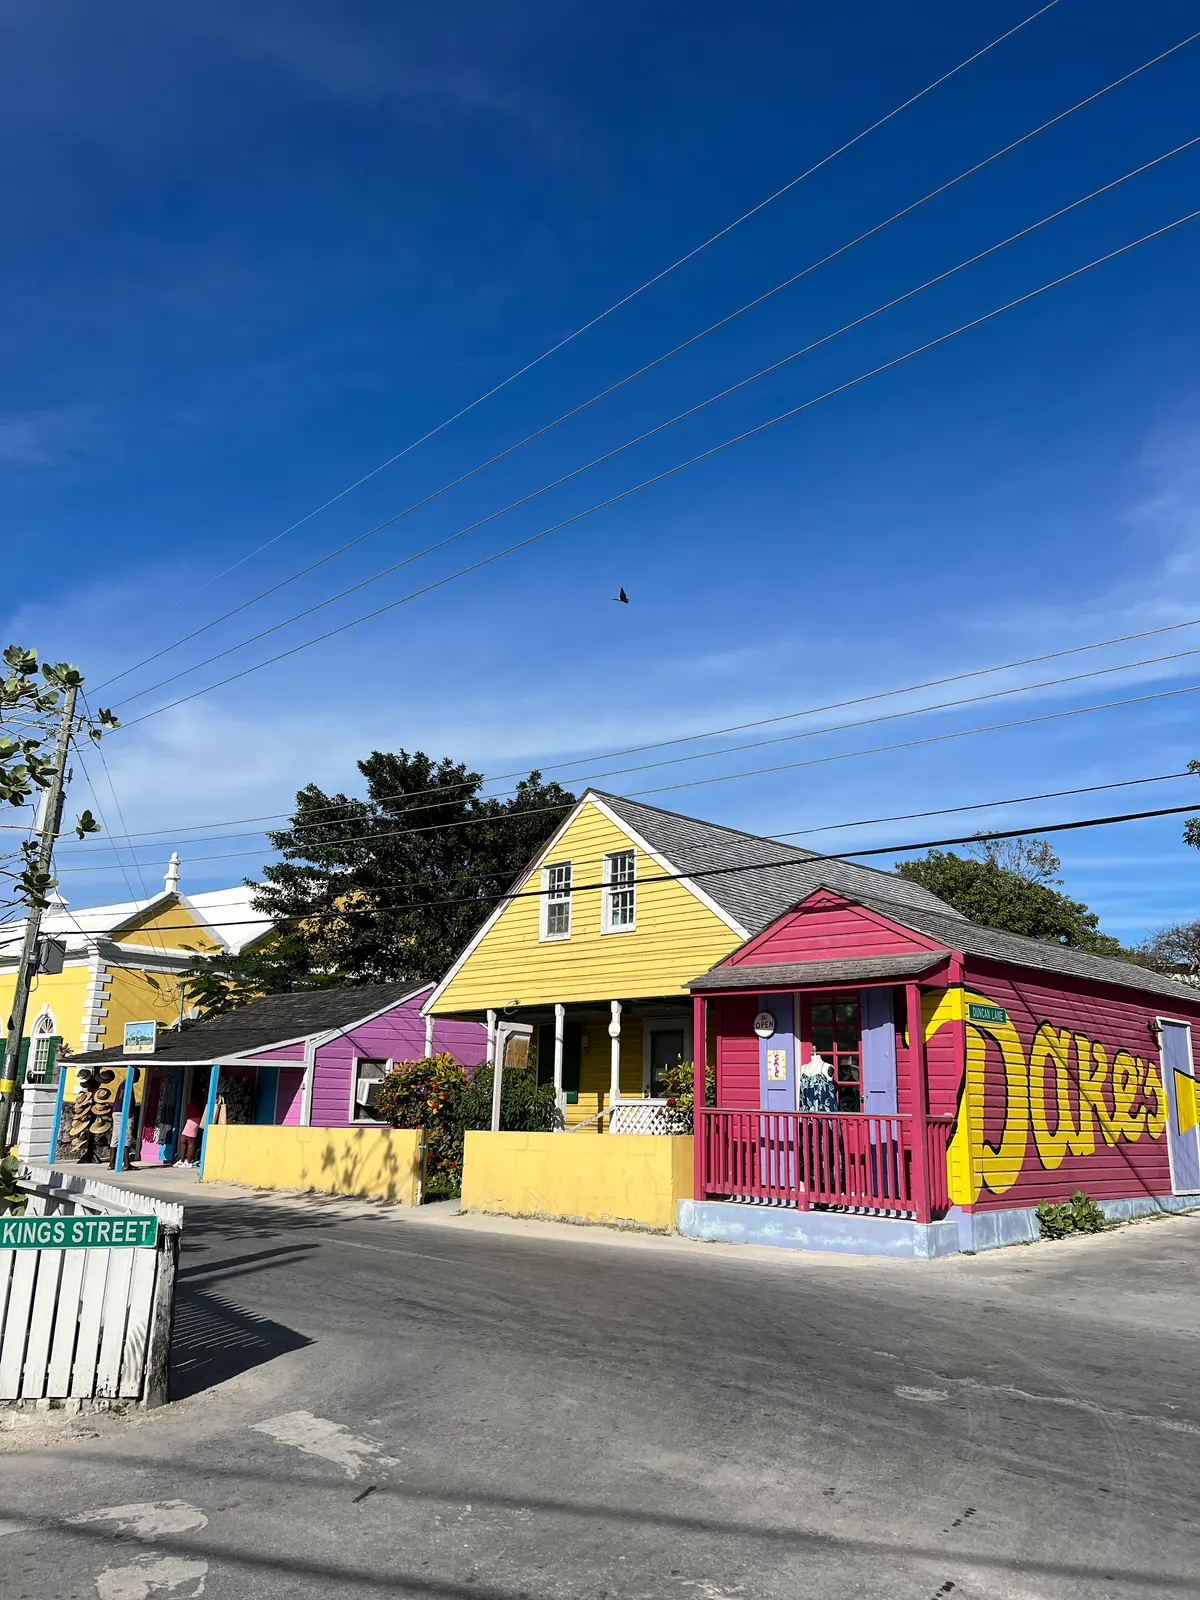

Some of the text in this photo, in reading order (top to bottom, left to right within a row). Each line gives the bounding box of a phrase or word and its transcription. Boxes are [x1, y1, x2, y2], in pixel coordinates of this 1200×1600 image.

[972, 1006, 1003, 1021] DUNCAN LANE
[755, 1021, 774, 1029] OPEN
[2, 1221, 151, 1244] KINGS STREET
